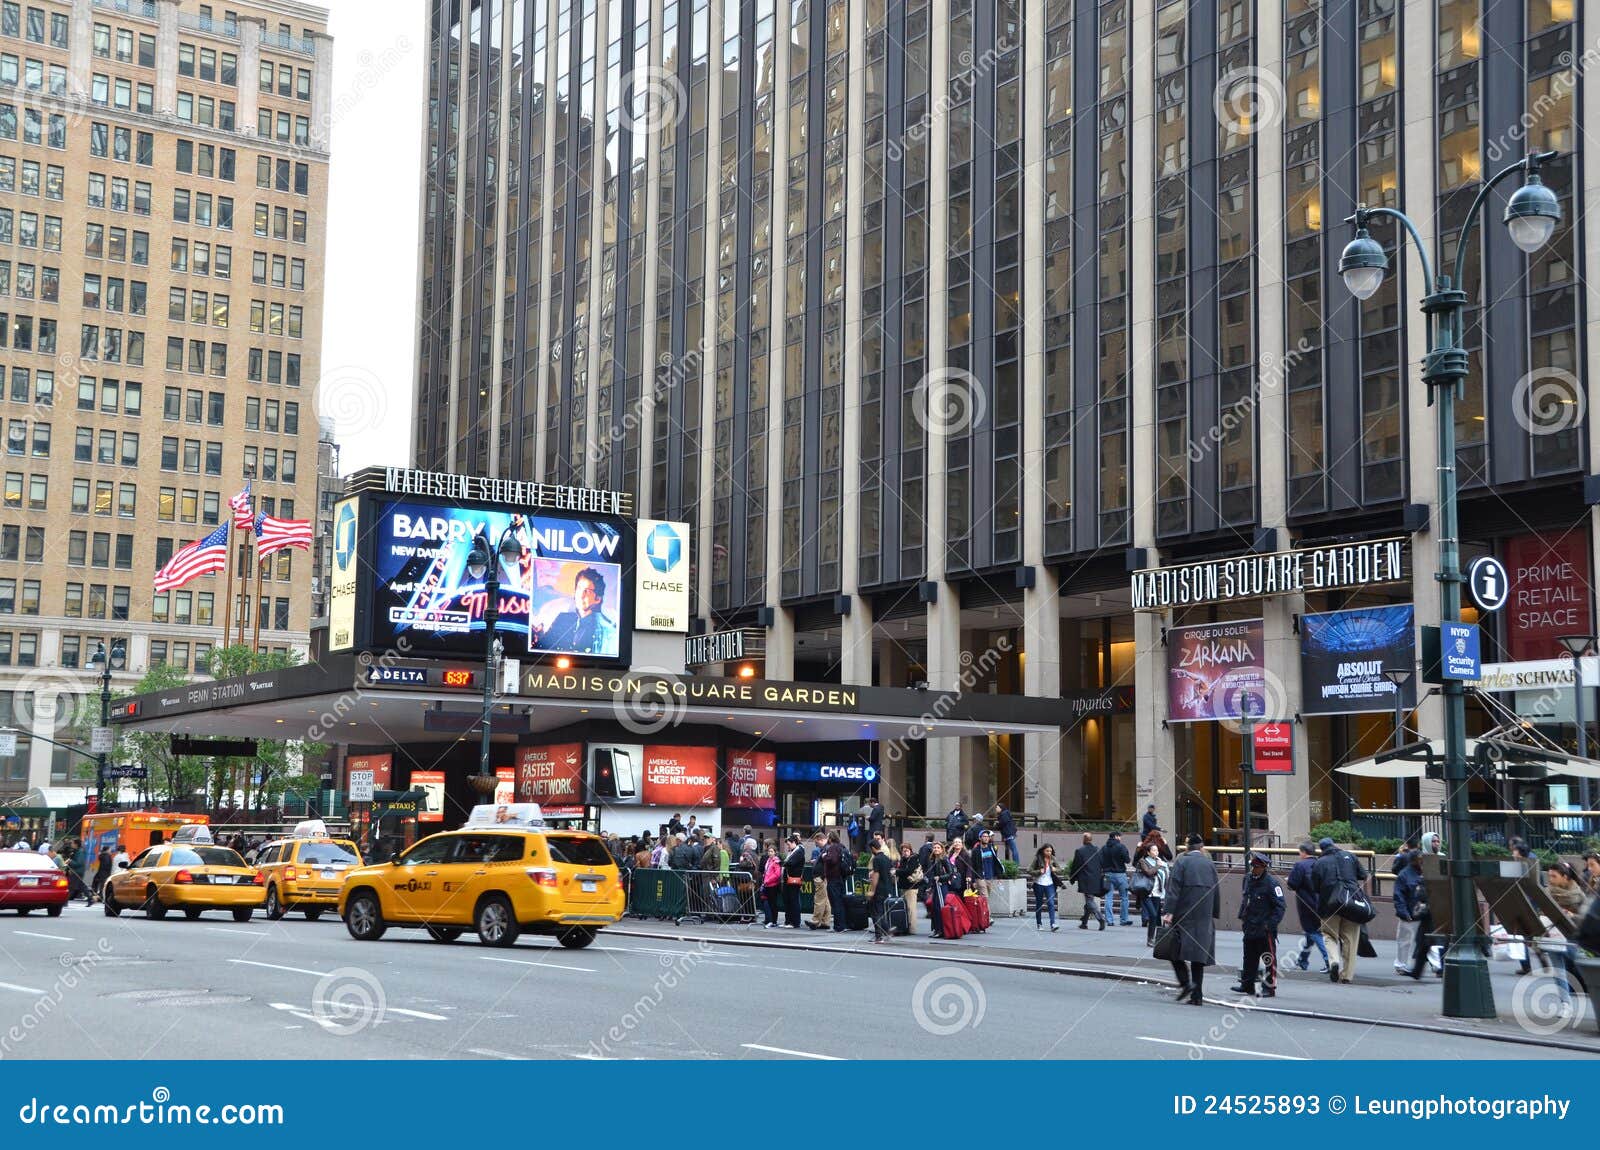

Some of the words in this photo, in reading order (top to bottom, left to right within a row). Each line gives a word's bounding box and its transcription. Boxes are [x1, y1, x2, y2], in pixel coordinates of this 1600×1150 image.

[385, 468, 470, 499] MADISON
[479, 477, 546, 506] SQUARE
[555, 485, 621, 515] GARDEN
[393, 514, 485, 544] BARRY
[490, 525, 620, 557] MNILOW
[391, 545, 415, 557] NEW
[1131, 563, 1218, 608] MADISON
[1225, 553, 1304, 597] SQUARE
[1313, 541, 1401, 588] GARDEN
[1517, 562, 1573, 584] PRIME
[332, 581, 357, 599] CHASE
[642, 580, 683, 593] CHASE
[1518, 586, 1582, 607] RETAIL
[650, 616, 675, 627] GARDEN
[1519, 608, 1578, 629] SPACE
[1184, 629, 1211, 640] CIRQUE
[1212, 628, 1223, 637] DU
[1224, 625, 1251, 636] SOLEIL
[1450, 627, 1470, 637] NYPD
[686, 637, 708, 665] UARE
[709, 631, 743, 662] GARDEN
[1179, 639, 1256, 669] ZARKANA
[1337, 660, 1383, 677] ABSOLUT
[1448, 655, 1475, 668] Security
[384, 671, 424, 681] DELTA
[446, 671, 469, 684] 6:37
[1449, 665, 1475, 675] Camera
[1479, 667, 1513, 687] arles
[188, 688, 209, 704] PENN
[212, 682, 245, 701] STATION
[528, 673, 641, 694] MADISON
[656, 680, 753, 701] SQUARE
[764, 687, 856, 706] GARDEN
[1321, 684, 1349, 698] MADISON
[1350, 682, 1373, 693] SQUARE
[522, 762, 555, 778] FASTEST
[648, 758, 678, 766] AMERICA'S
[648, 765, 686, 776] LARGEST
[732, 767, 758, 782] FASTEST
[820, 766, 863, 779] CHASE
[521, 780, 532, 796] 4G
[532, 778, 575, 796] NETWORK.
[670, 775, 713, 786] NETWORK.
[730, 782, 740, 797] 4G
[740, 783, 772, 799] NETWORK.
